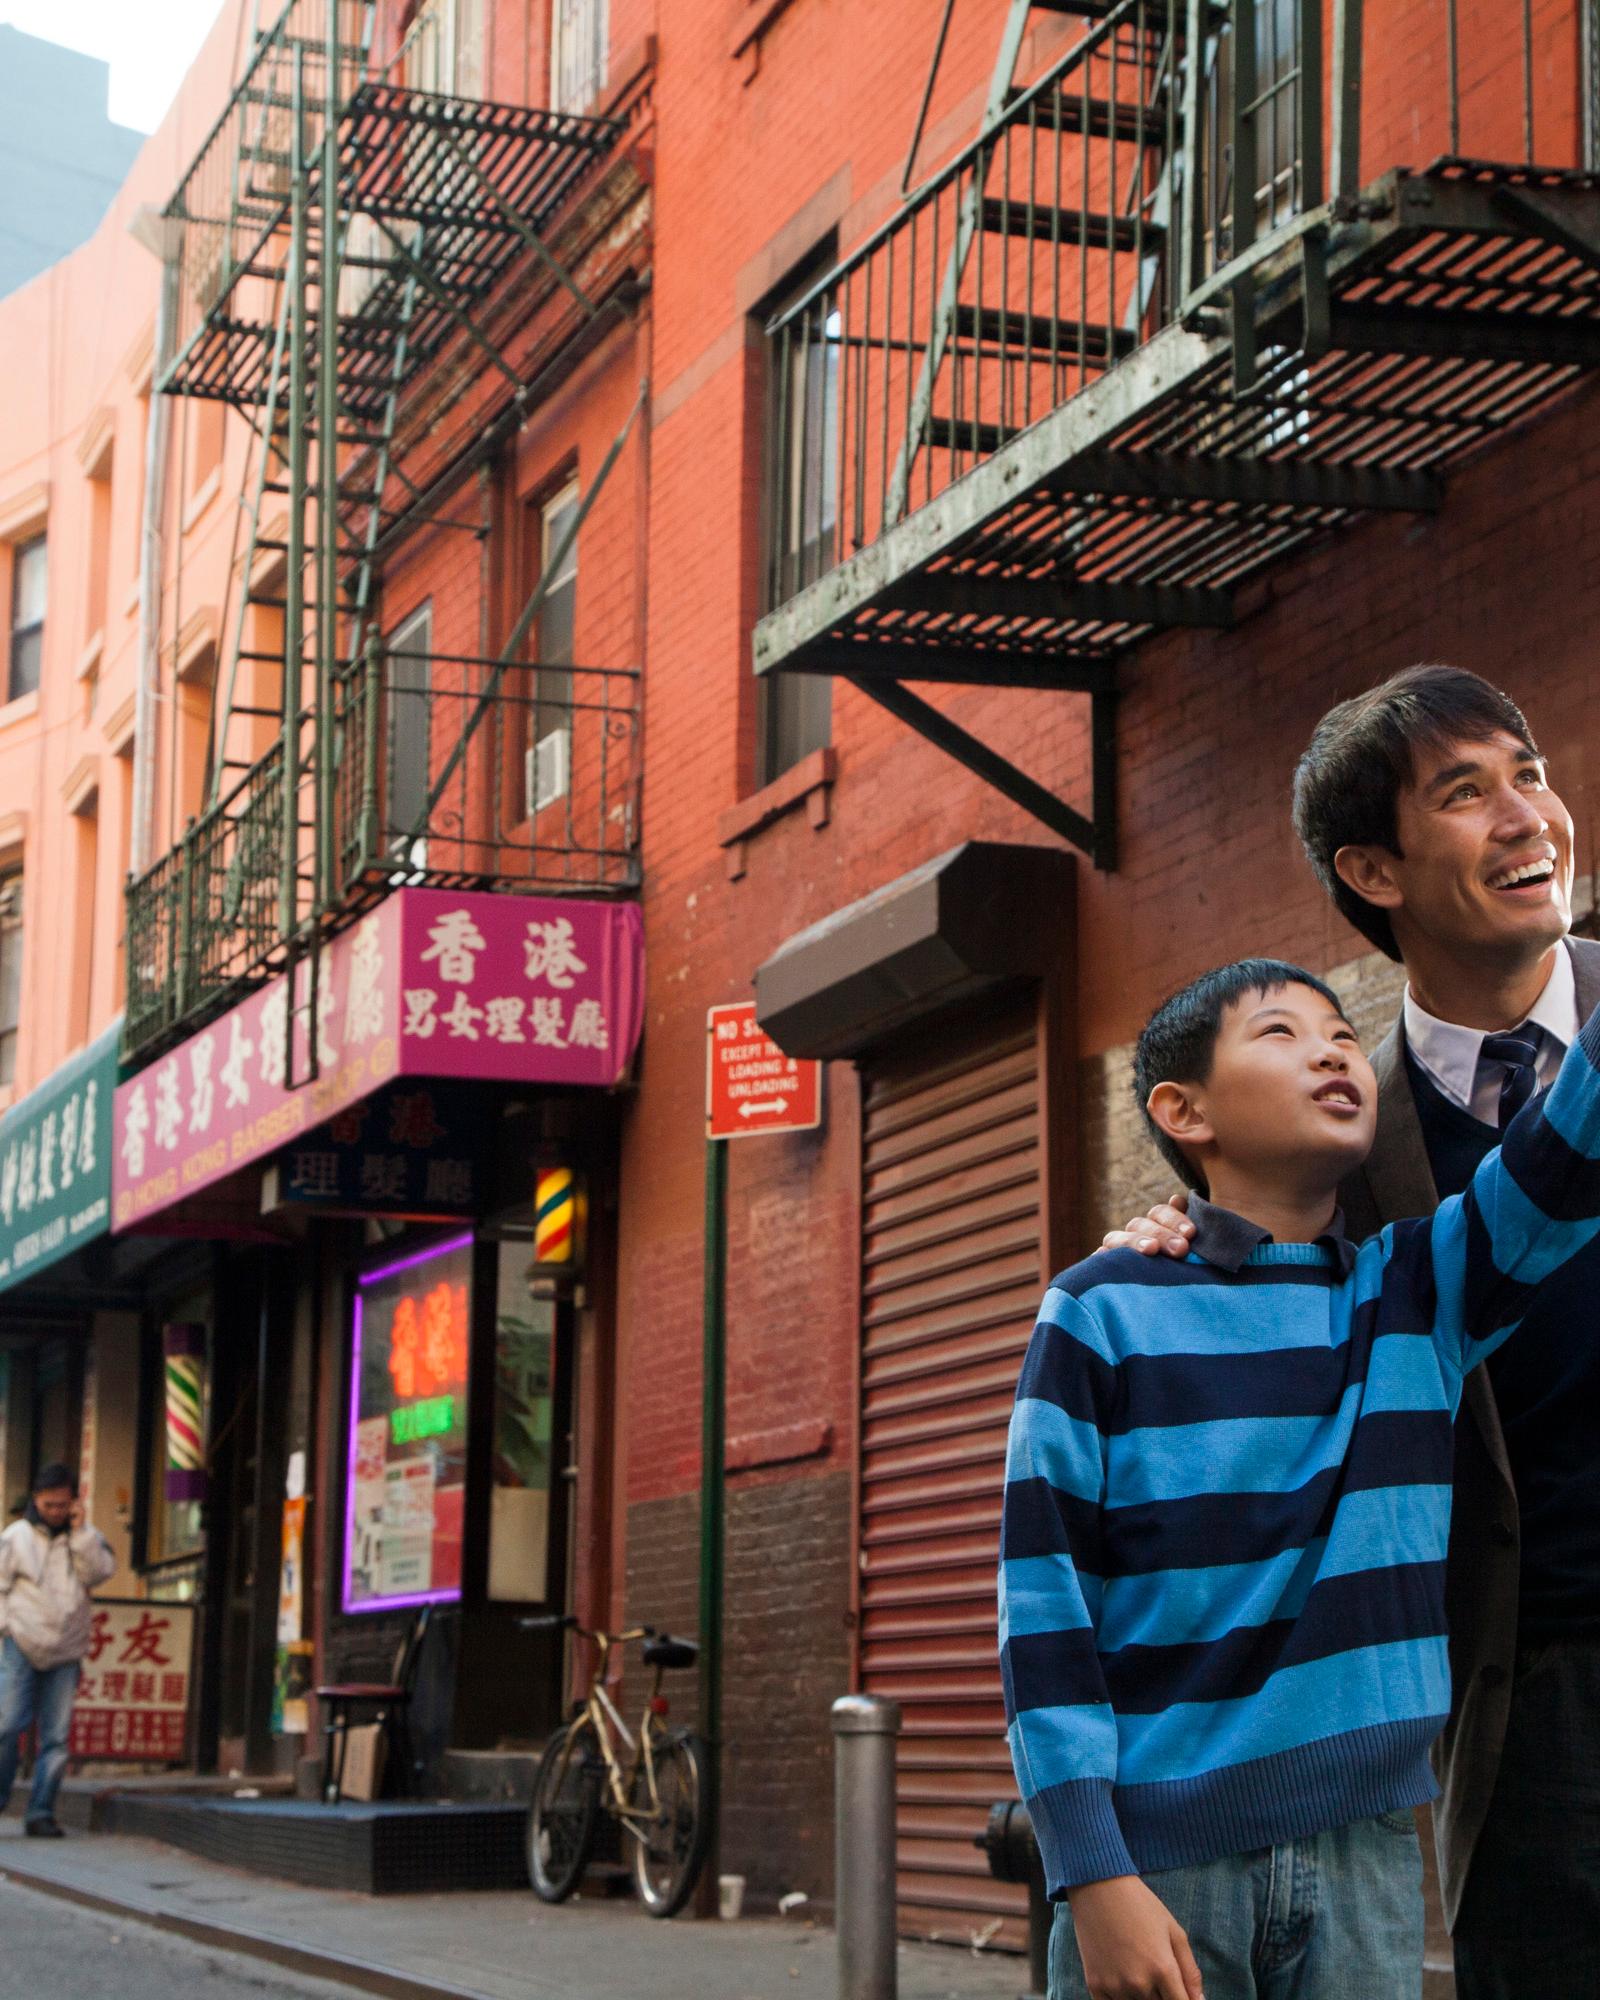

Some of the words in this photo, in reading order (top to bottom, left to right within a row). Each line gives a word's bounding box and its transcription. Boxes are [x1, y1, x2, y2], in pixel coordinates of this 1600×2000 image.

[420, 908, 588, 990] 香港
[402, 987, 609, 1049] 男女理髮廳
[717, 1020, 738, 1040] NO
[134, 1165, 178, 1204] HONG
[181, 1138, 227, 1181] KONG
[230, 1093, 305, 1162] BARBER
